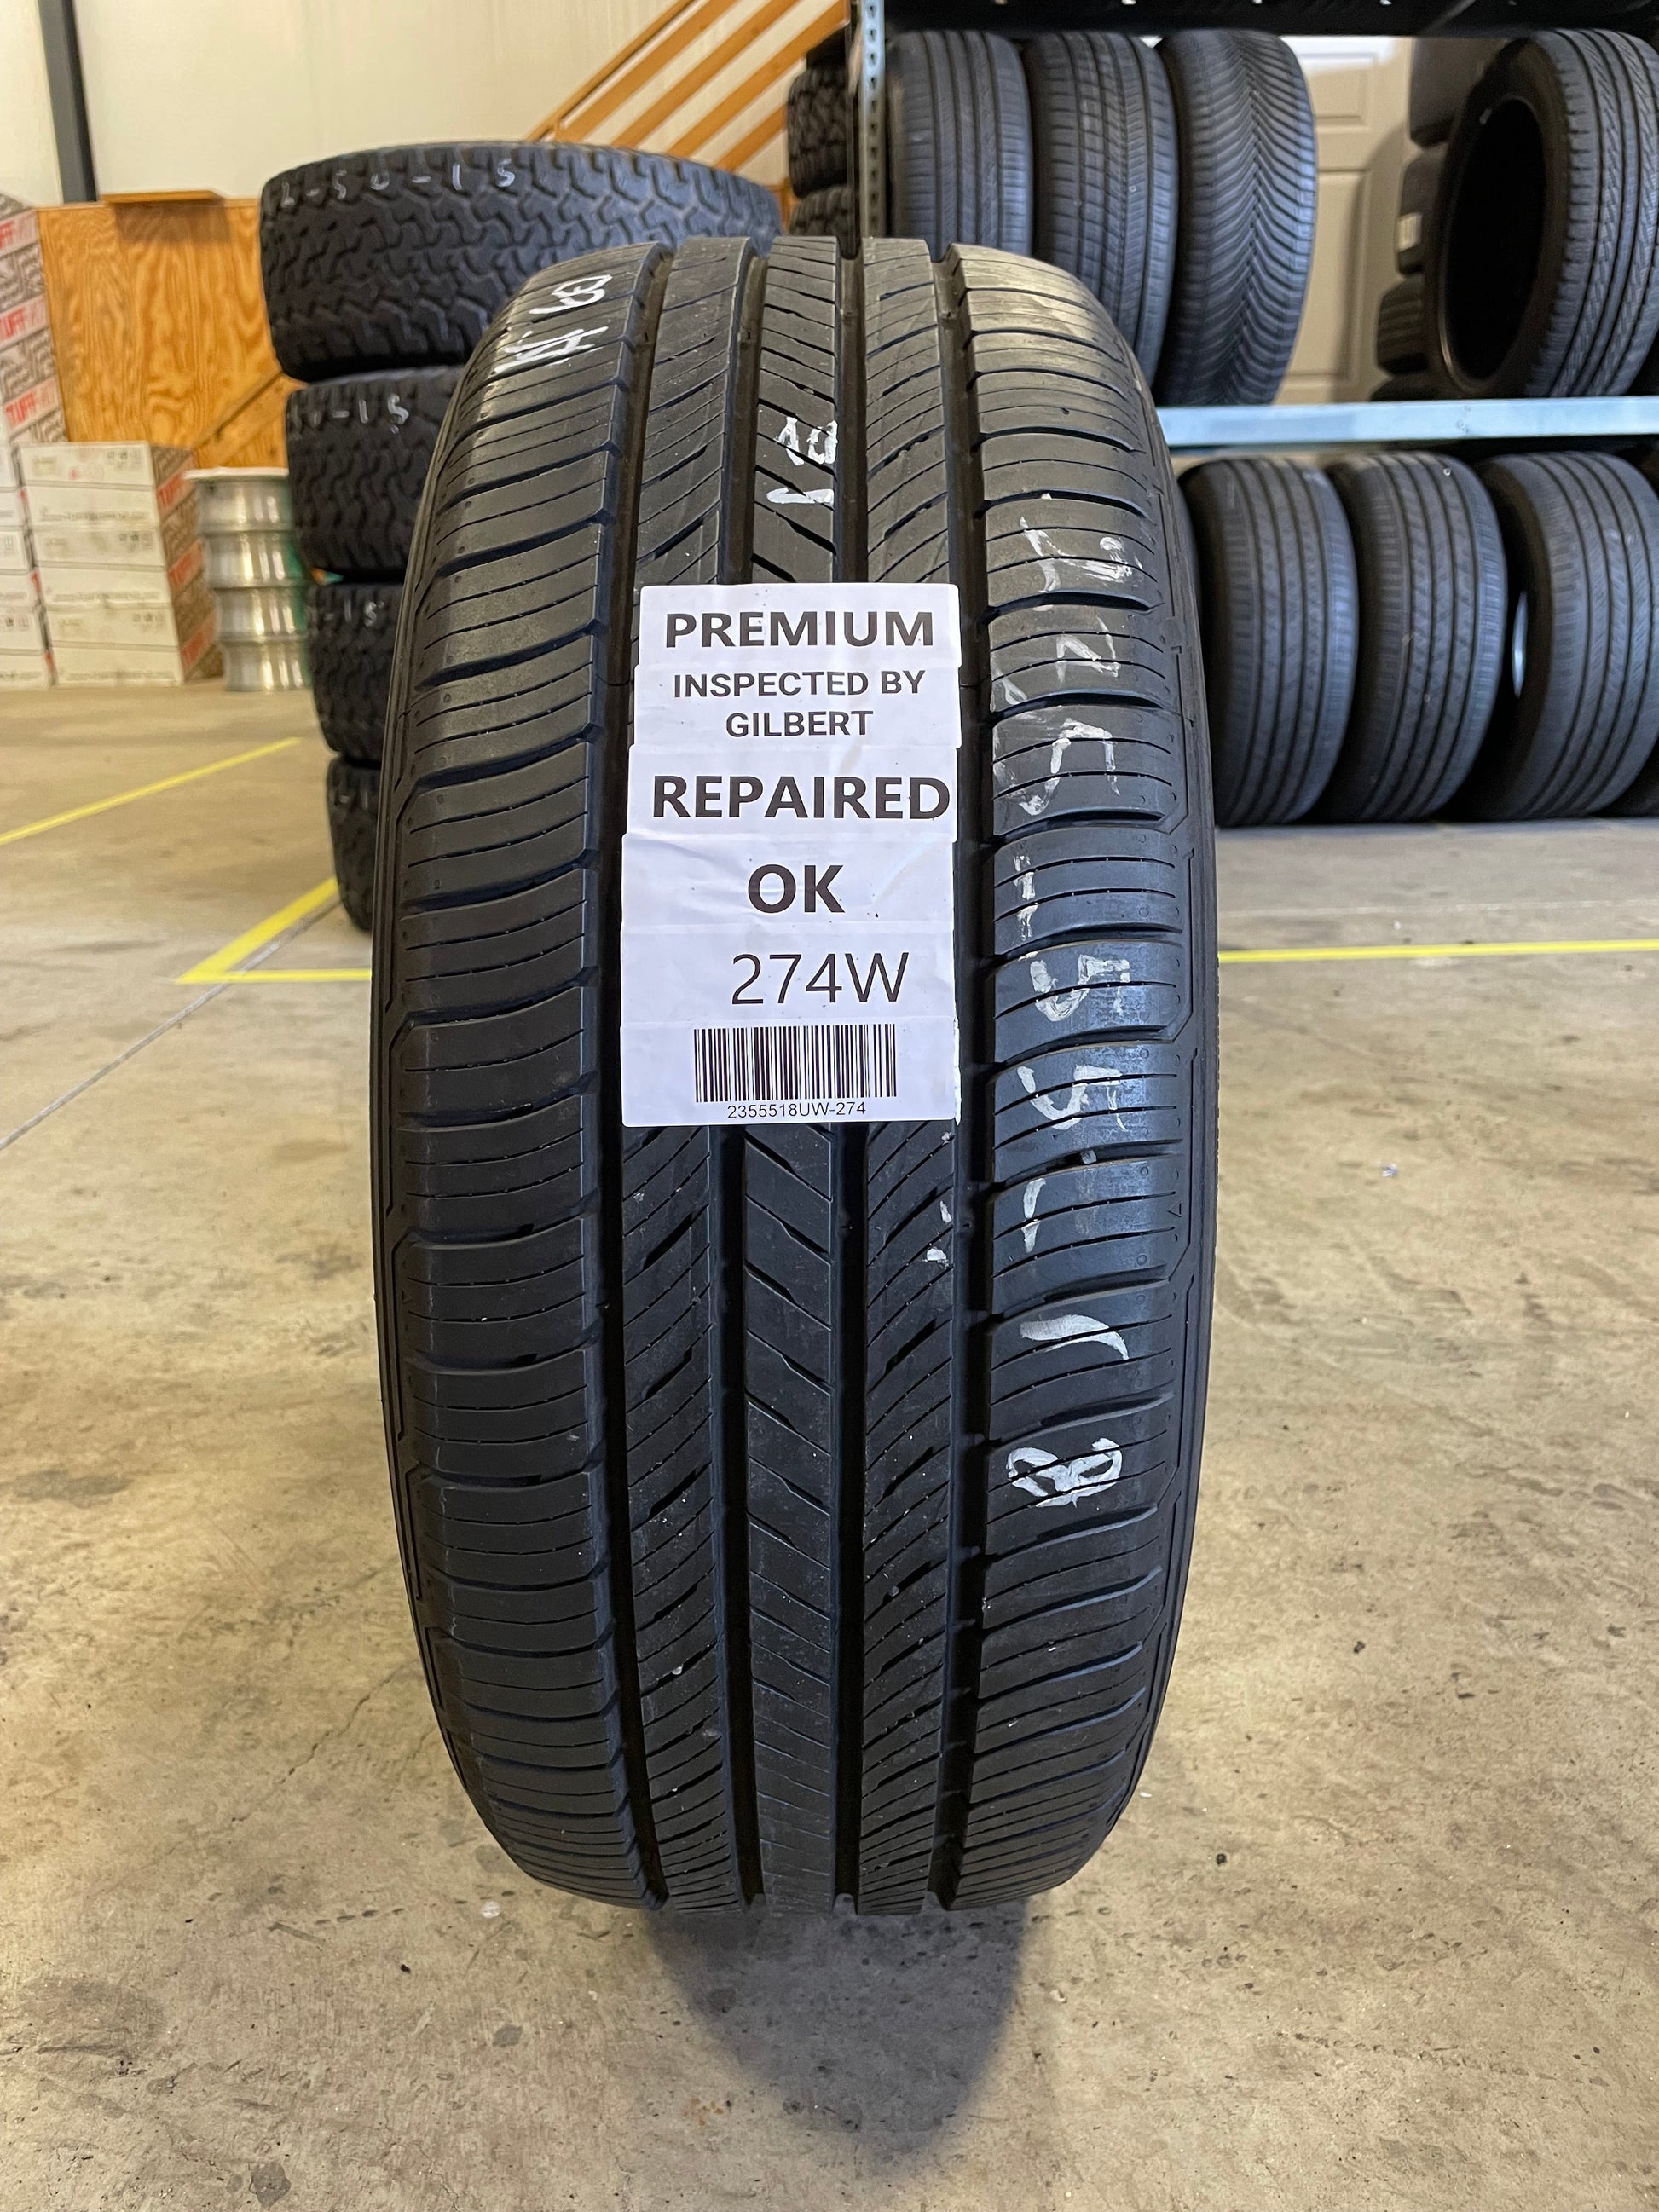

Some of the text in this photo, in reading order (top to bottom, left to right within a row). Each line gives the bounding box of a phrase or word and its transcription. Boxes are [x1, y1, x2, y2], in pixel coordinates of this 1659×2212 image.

[666, 611, 934, 649] PREMIUM
[674, 670, 926, 698] INSPECTED BY
[726, 710, 874, 738] GILBERT
[653, 775, 951, 821] REPAIRED
[748, 863, 846, 914] OK
[731, 952, 910, 1005] 274W
[727, 1101, 866, 1118] 2355518UW-274
